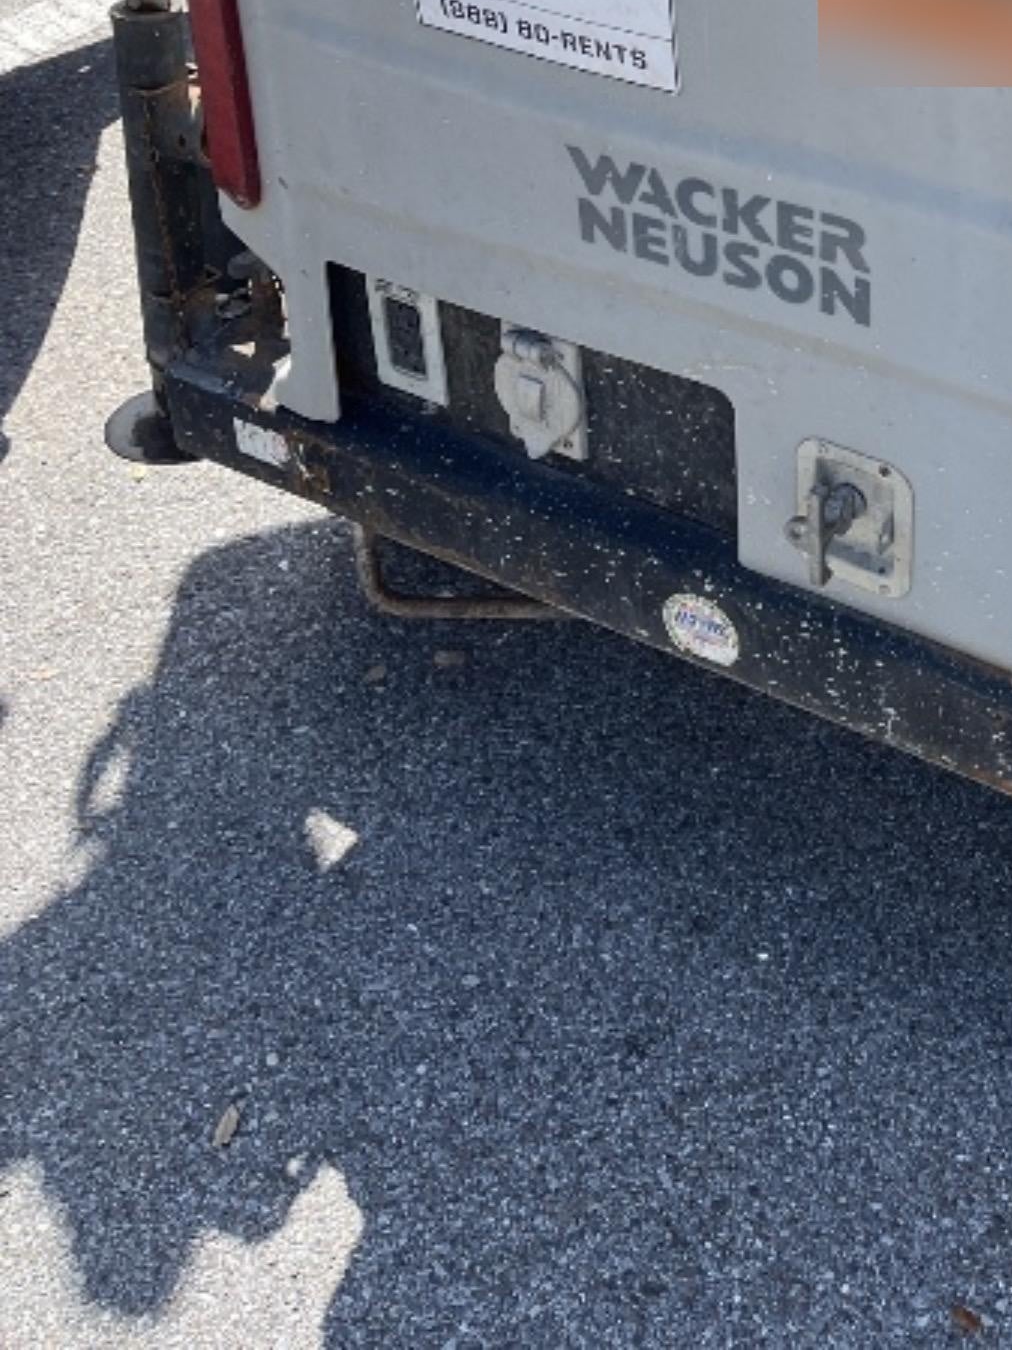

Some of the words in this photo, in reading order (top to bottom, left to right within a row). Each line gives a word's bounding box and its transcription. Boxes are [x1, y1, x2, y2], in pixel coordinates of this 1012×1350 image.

[517, 19, 648, 70] 80-RENTS
[564, 143, 871, 274] WACKER
[578, 197, 871, 328] NEUSON
